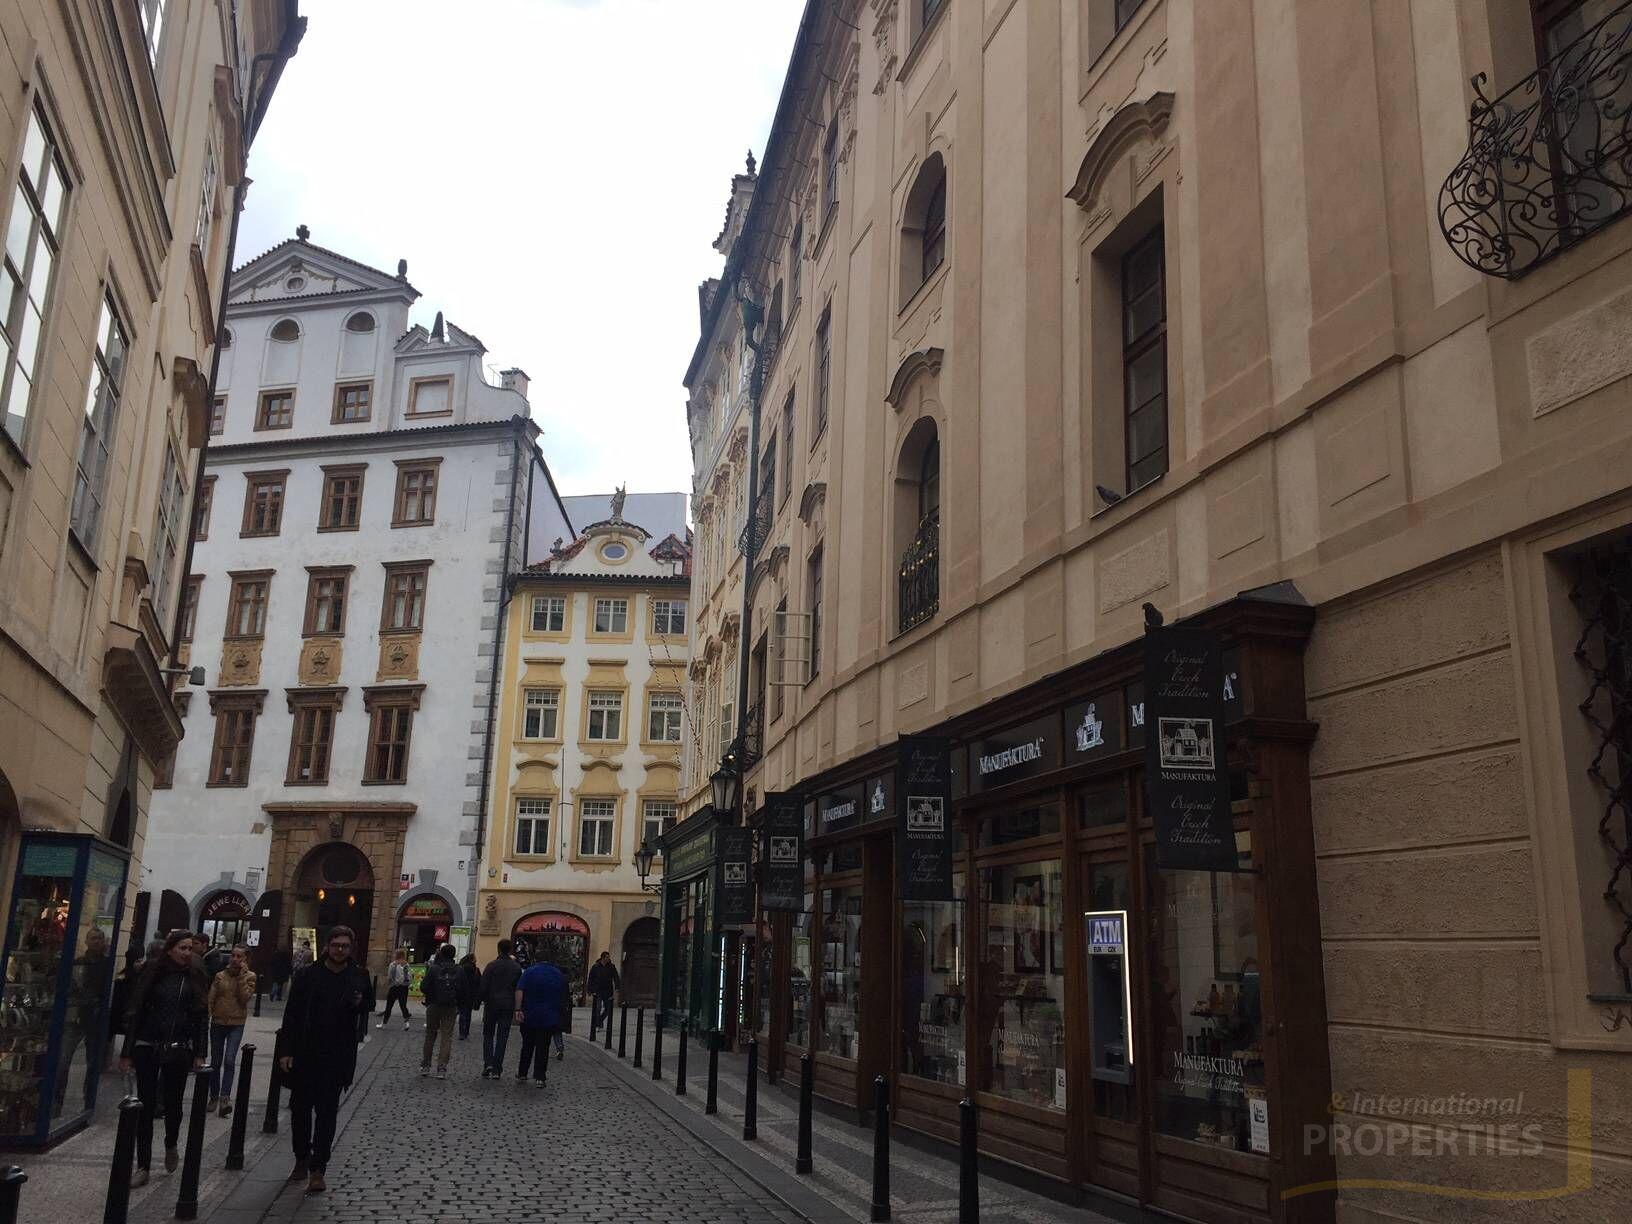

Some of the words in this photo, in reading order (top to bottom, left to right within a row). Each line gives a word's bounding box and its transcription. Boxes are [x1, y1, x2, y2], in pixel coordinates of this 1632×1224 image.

[1161, 771, 1216, 782] MANUFAKTURA
[1093, 920, 1121, 943] ATM
[1174, 1051, 1244, 1077] MANUFAKTURA
